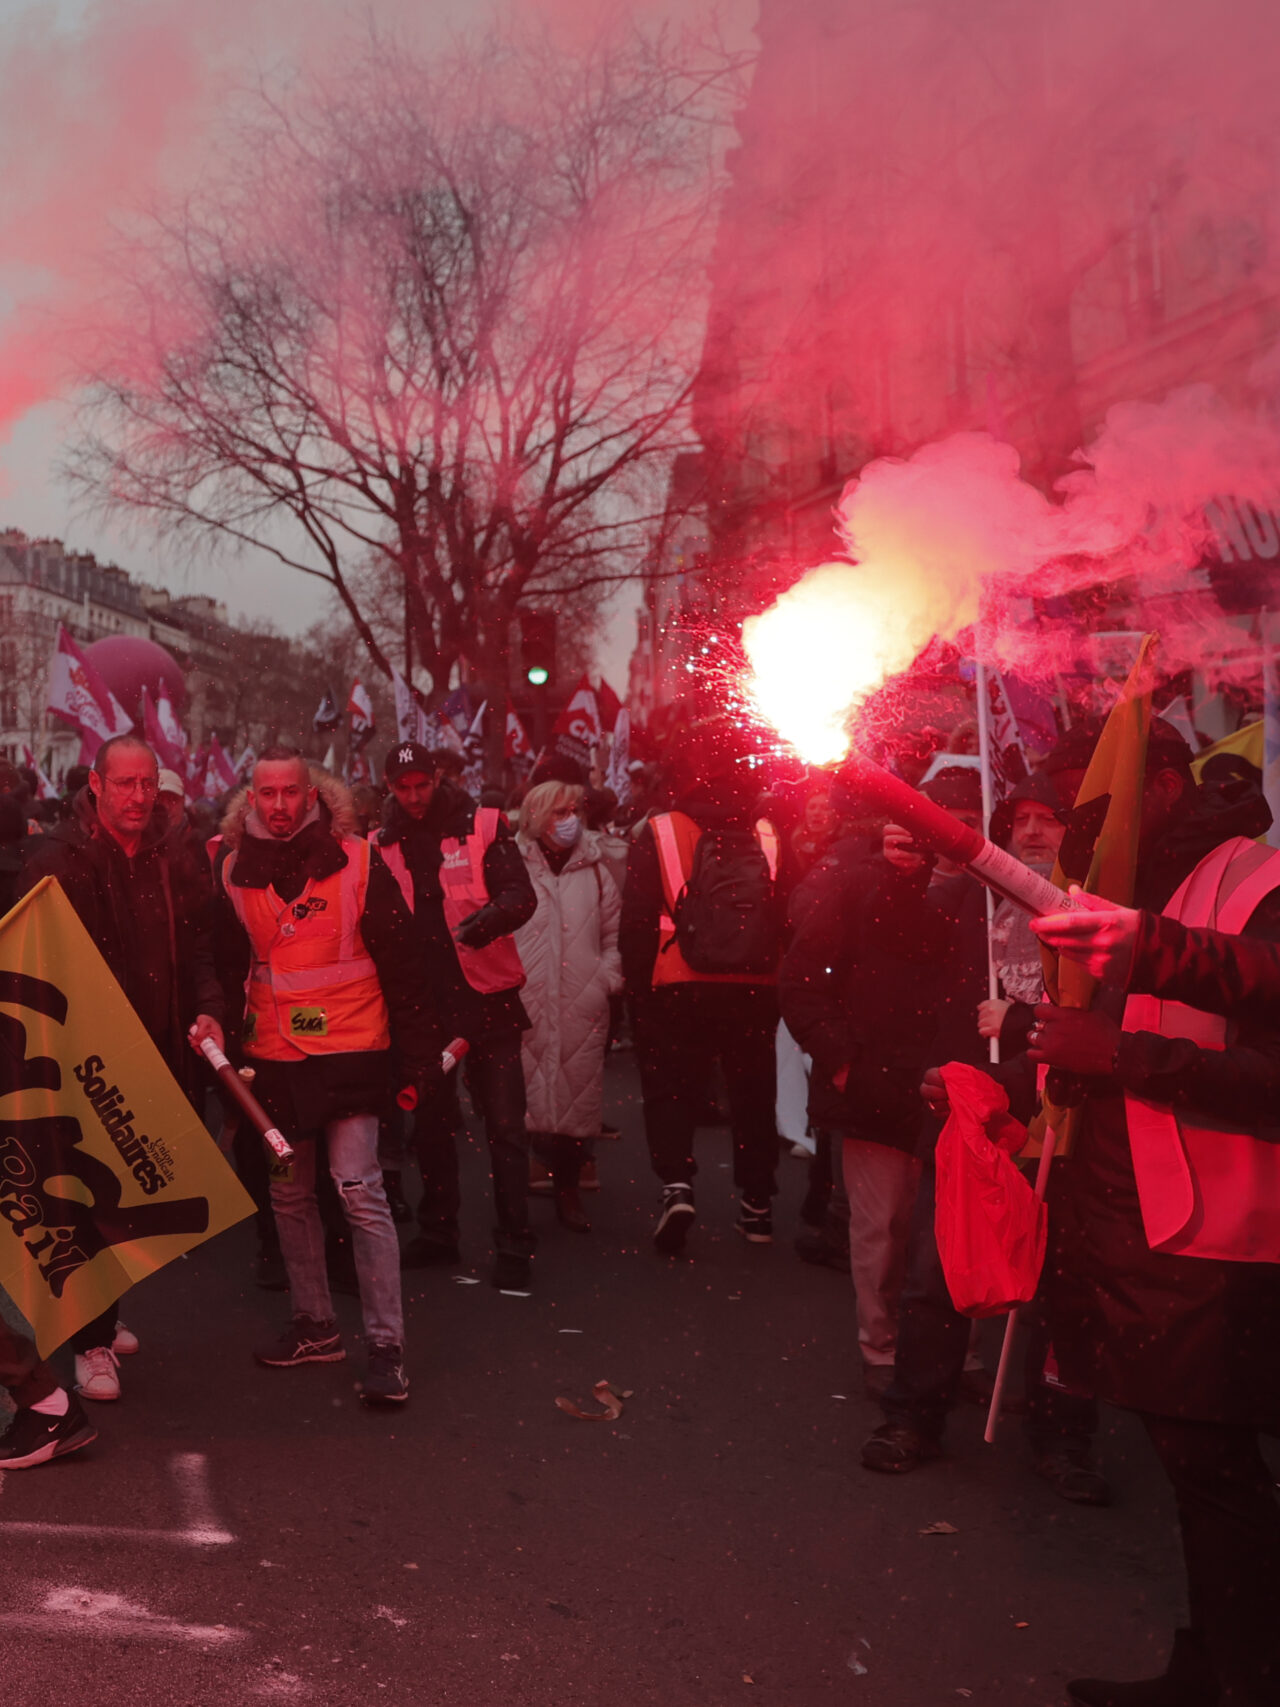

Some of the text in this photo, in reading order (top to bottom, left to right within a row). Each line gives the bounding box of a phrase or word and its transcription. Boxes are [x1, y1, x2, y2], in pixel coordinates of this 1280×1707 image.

[398, 747, 414, 763] NY
[73, 1055, 167, 1195] Solidaires
[147, 1142, 175, 1182] Syndicale
[154, 1137, 174, 1167] Union
